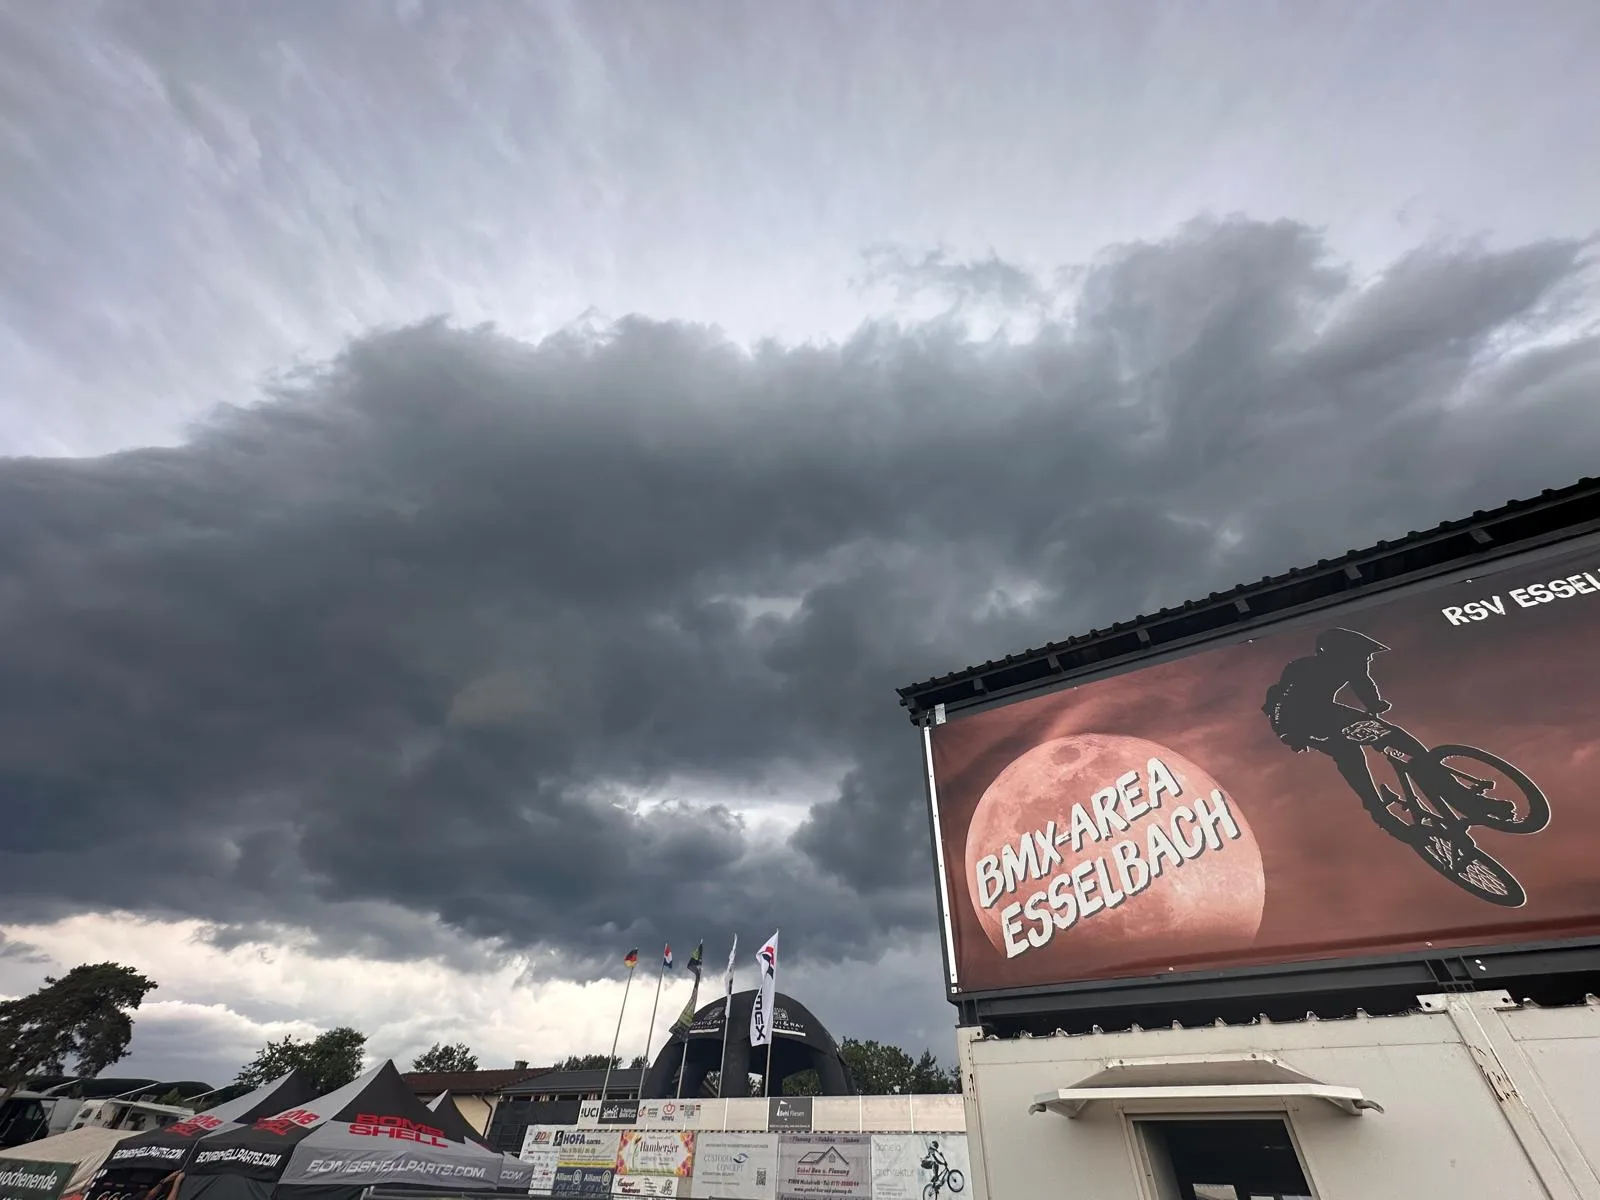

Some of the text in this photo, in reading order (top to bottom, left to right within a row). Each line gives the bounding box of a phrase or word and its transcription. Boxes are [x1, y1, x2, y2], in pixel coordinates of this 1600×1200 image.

[1442, 568, 1600, 626] RSV ESSEL
[976, 757, 1182, 908] BMX-AREA
[1001, 789, 1241, 958] ESSELBACH
[348, 1123, 448, 1148] SHELL
[563, 1134, 585, 1144] HOFA
[195, 1148, 282, 1168] BOMBSHELLPARTS.COM
[306, 1159, 487, 1179] BOMBSHELLPARTS.COM
